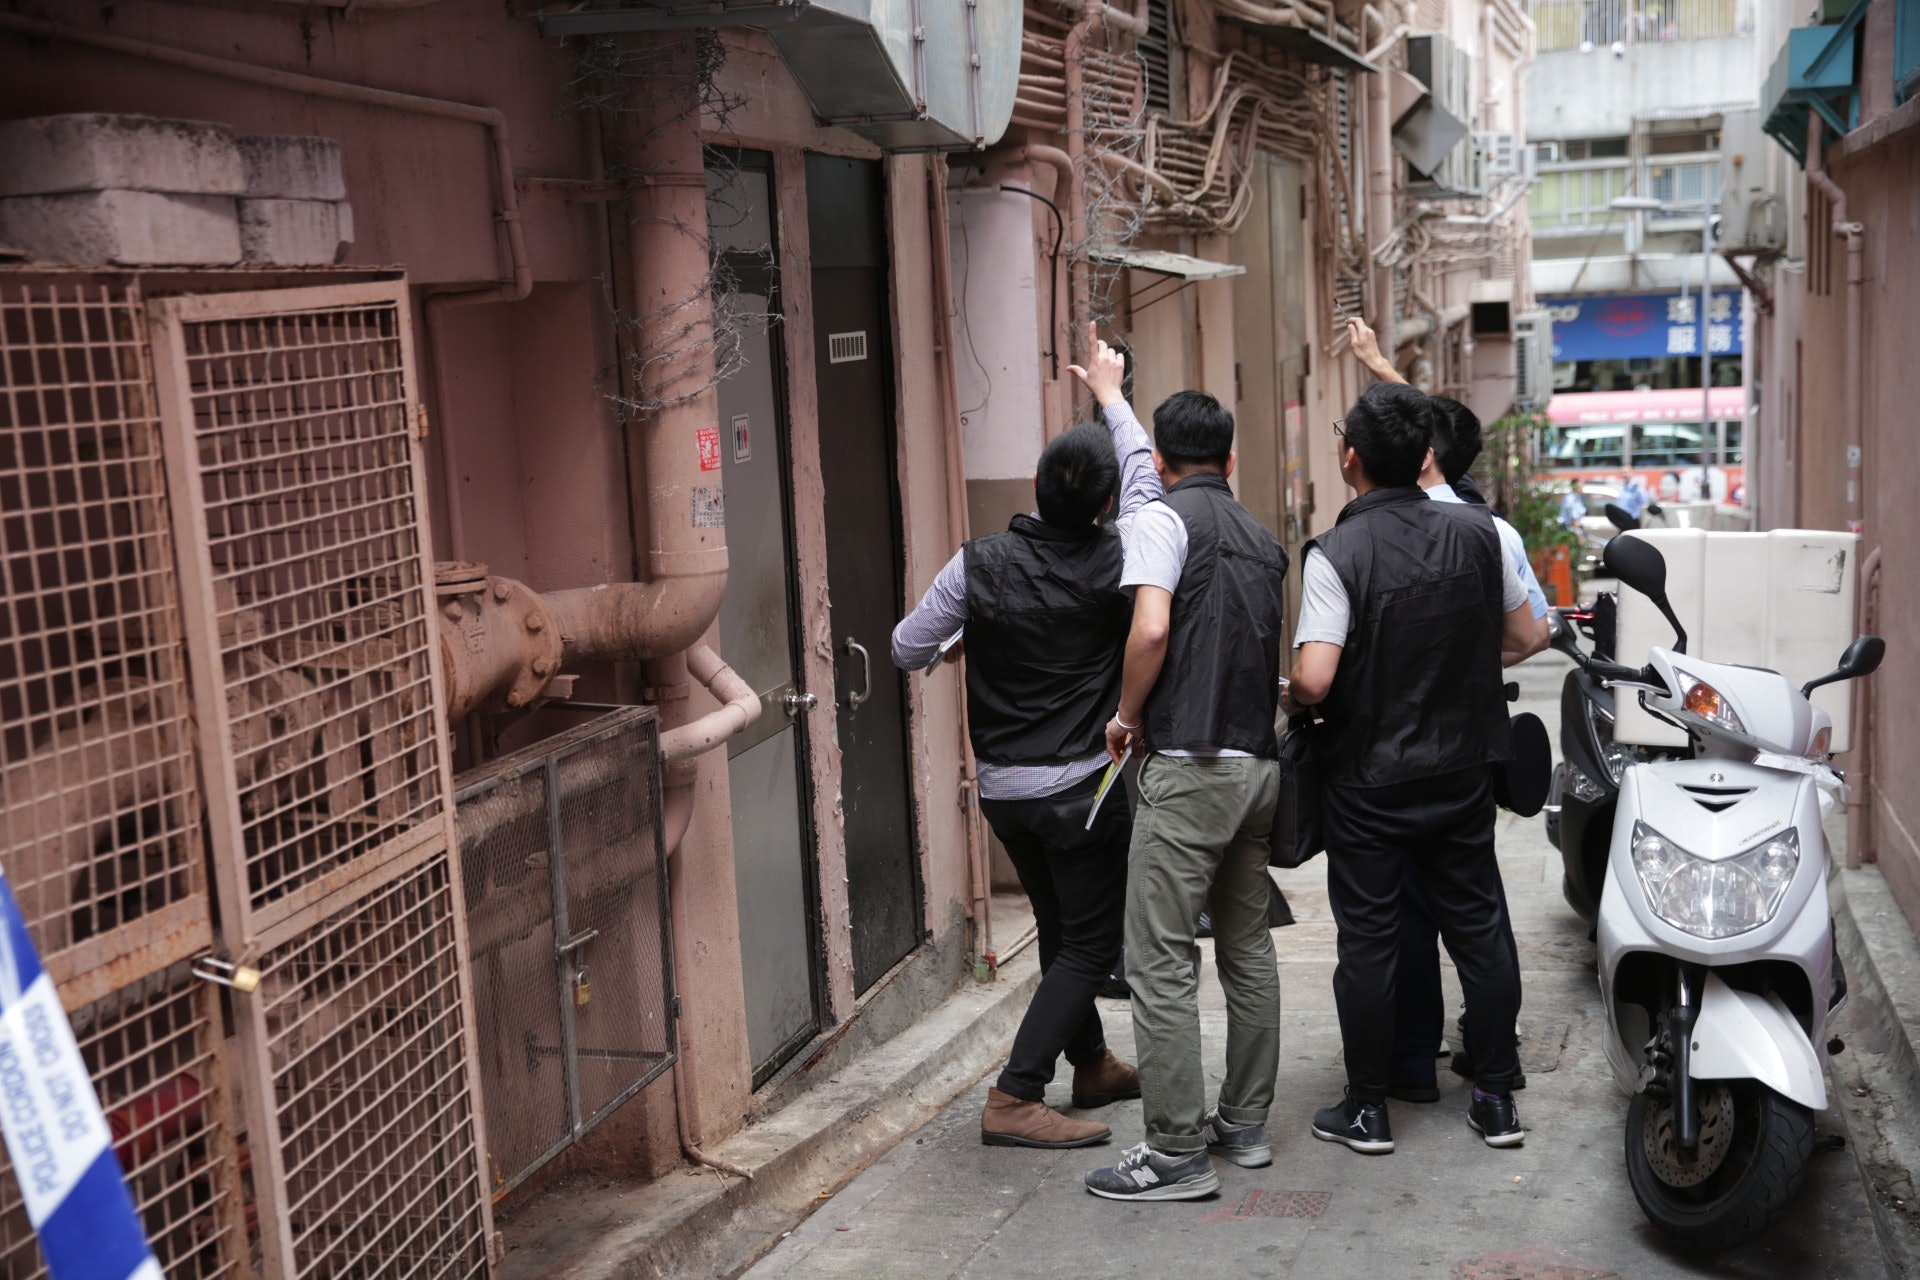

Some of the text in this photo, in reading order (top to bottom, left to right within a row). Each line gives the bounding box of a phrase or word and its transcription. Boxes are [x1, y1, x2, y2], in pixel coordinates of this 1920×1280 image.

[0, 1040, 60, 1195] POLICE CORDON
[22, 1003, 89, 1142] DO NOT CROSS
[1130, 1165, 1160, 1188] N
